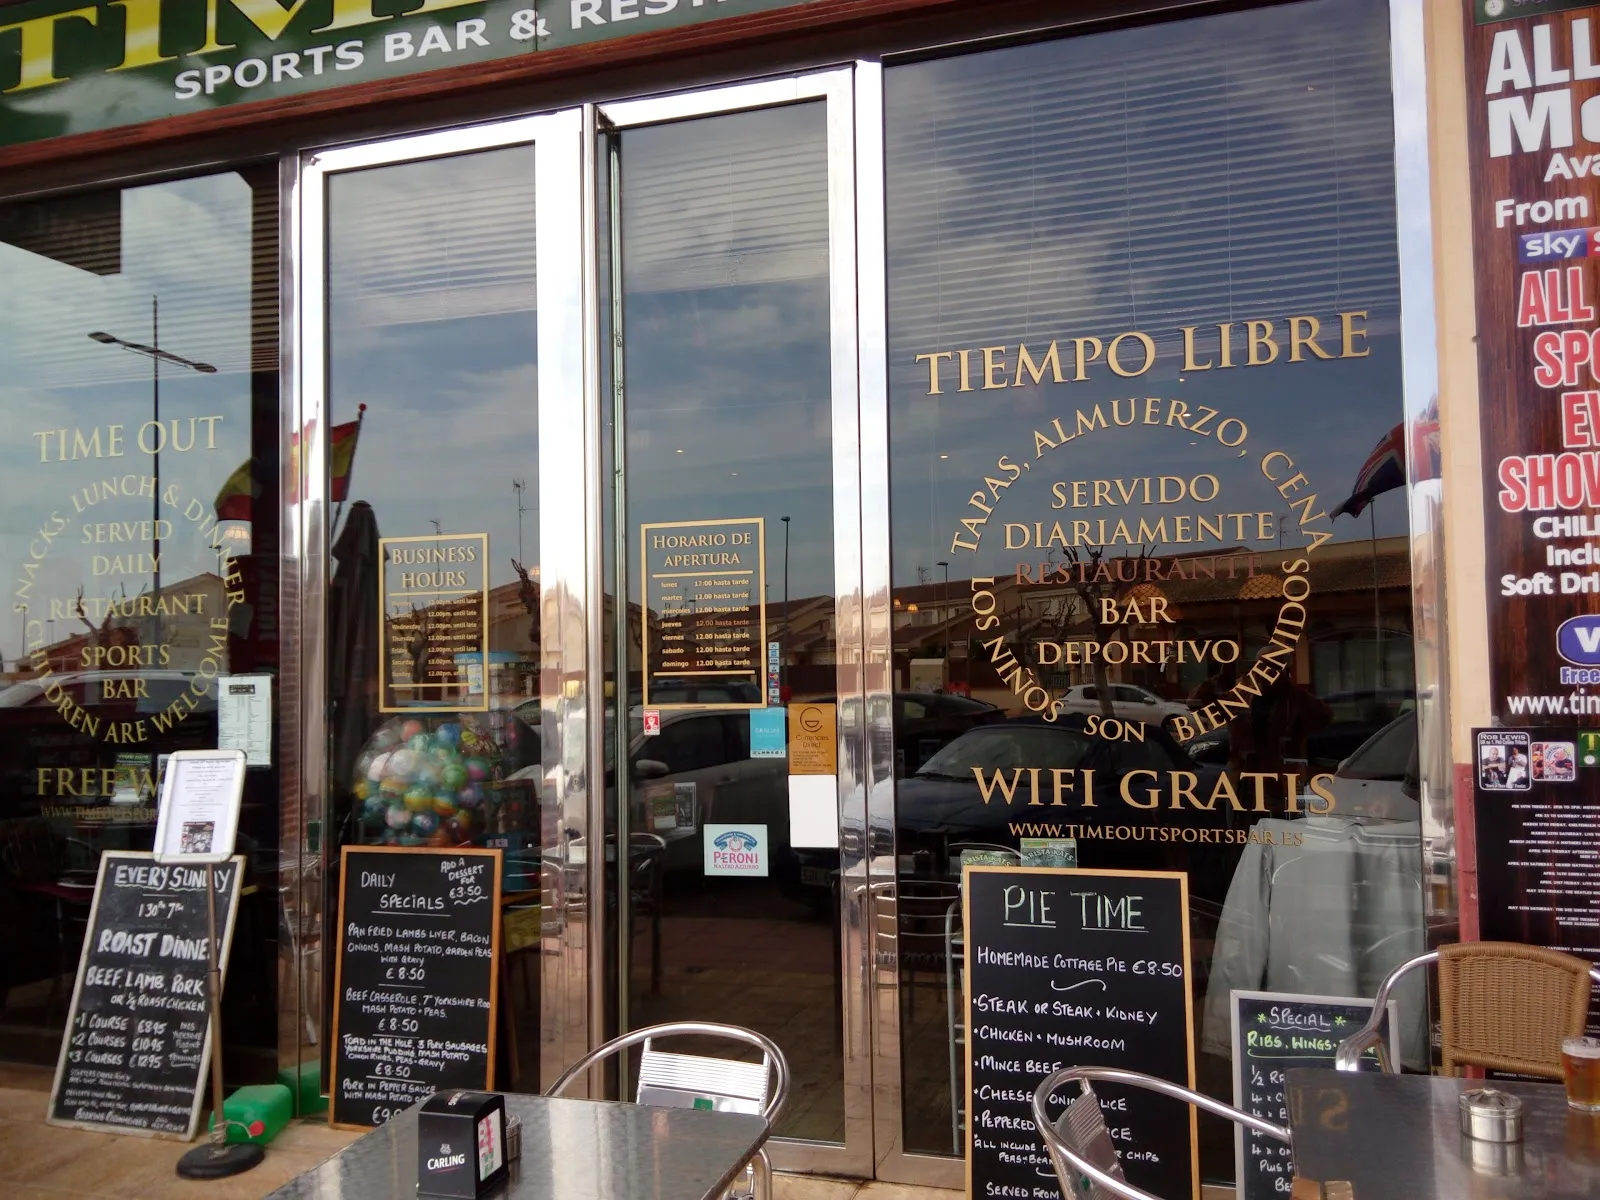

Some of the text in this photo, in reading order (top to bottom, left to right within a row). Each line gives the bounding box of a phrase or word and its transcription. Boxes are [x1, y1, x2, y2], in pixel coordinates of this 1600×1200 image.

[0, 0, 488, 94] TIM
[174, 40, 365, 99] SPORTS
[384, 17, 490, 63] BAR
[509, 8, 551, 41] &
[1484, 17, 1600, 95] ALL
[1495, 195, 1588, 228] From
[1525, 231, 1581, 258] sky
[1517, 266, 1594, 327] ALL
[914, 310, 1371, 396] TIEMPO LIBRE
[32, 415, 225, 464] TIME OUT
[950, 396, 1335, 556] TAPAS, ALMUERZO, CENA
[1050, 473, 1221, 510] SERVIDO
[81, 519, 173, 545] SERVED
[653, 532, 753, 549] HORARIO DE
[1002, 511, 1277, 551] DIARIAMENTE
[1533, 514, 1600, 539] CHIL
[13, 473, 246, 614] SNACKS, LUNCH & DINNER
[391, 546, 477, 565] BUSINESS
[90, 552, 164, 577] DAILY
[664, 552, 741, 568] APERTURA
[1014, 554, 1264, 586] RESTAURANTE
[401, 571, 467, 589] HOURS
[1500, 572, 1554, 597] Soft
[49, 592, 209, 621] RESTAURANT
[1098, 595, 1177, 626] BAR
[80, 644, 171, 668] SPORTS
[969, 557, 1311, 744] LOS NIÑOS SON BIENVENIDOS
[1037, 637, 1240, 667] DEPORTIVO
[26, 619, 102, 739] CHILDREN
[104, 719, 149, 745] ARE
[150, 616, 230, 734] WELCOME
[102, 678, 150, 700] BAR
[36, 767, 117, 797] FREE
[969, 766, 1337, 815] WIFI GRATIS
[713, 852, 758, 864] PERONI
[114, 865, 168, 891] EVERY
[360, 871, 396, 888] DAILY
[1003, 884, 1147, 931] PIE TIME
[97, 929, 220, 961] ROAST DINNE
[977, 946, 1050, 970] HOMEMADE
[1106, 956, 1127, 973] PIE
[1052, 1000, 1094, 1018] STEAK
[1105, 1006, 1158, 1026] KIDNEY
[1046, 1033, 1126, 1052] MUSHROOM
[427, 1154, 466, 1170] CARLING
